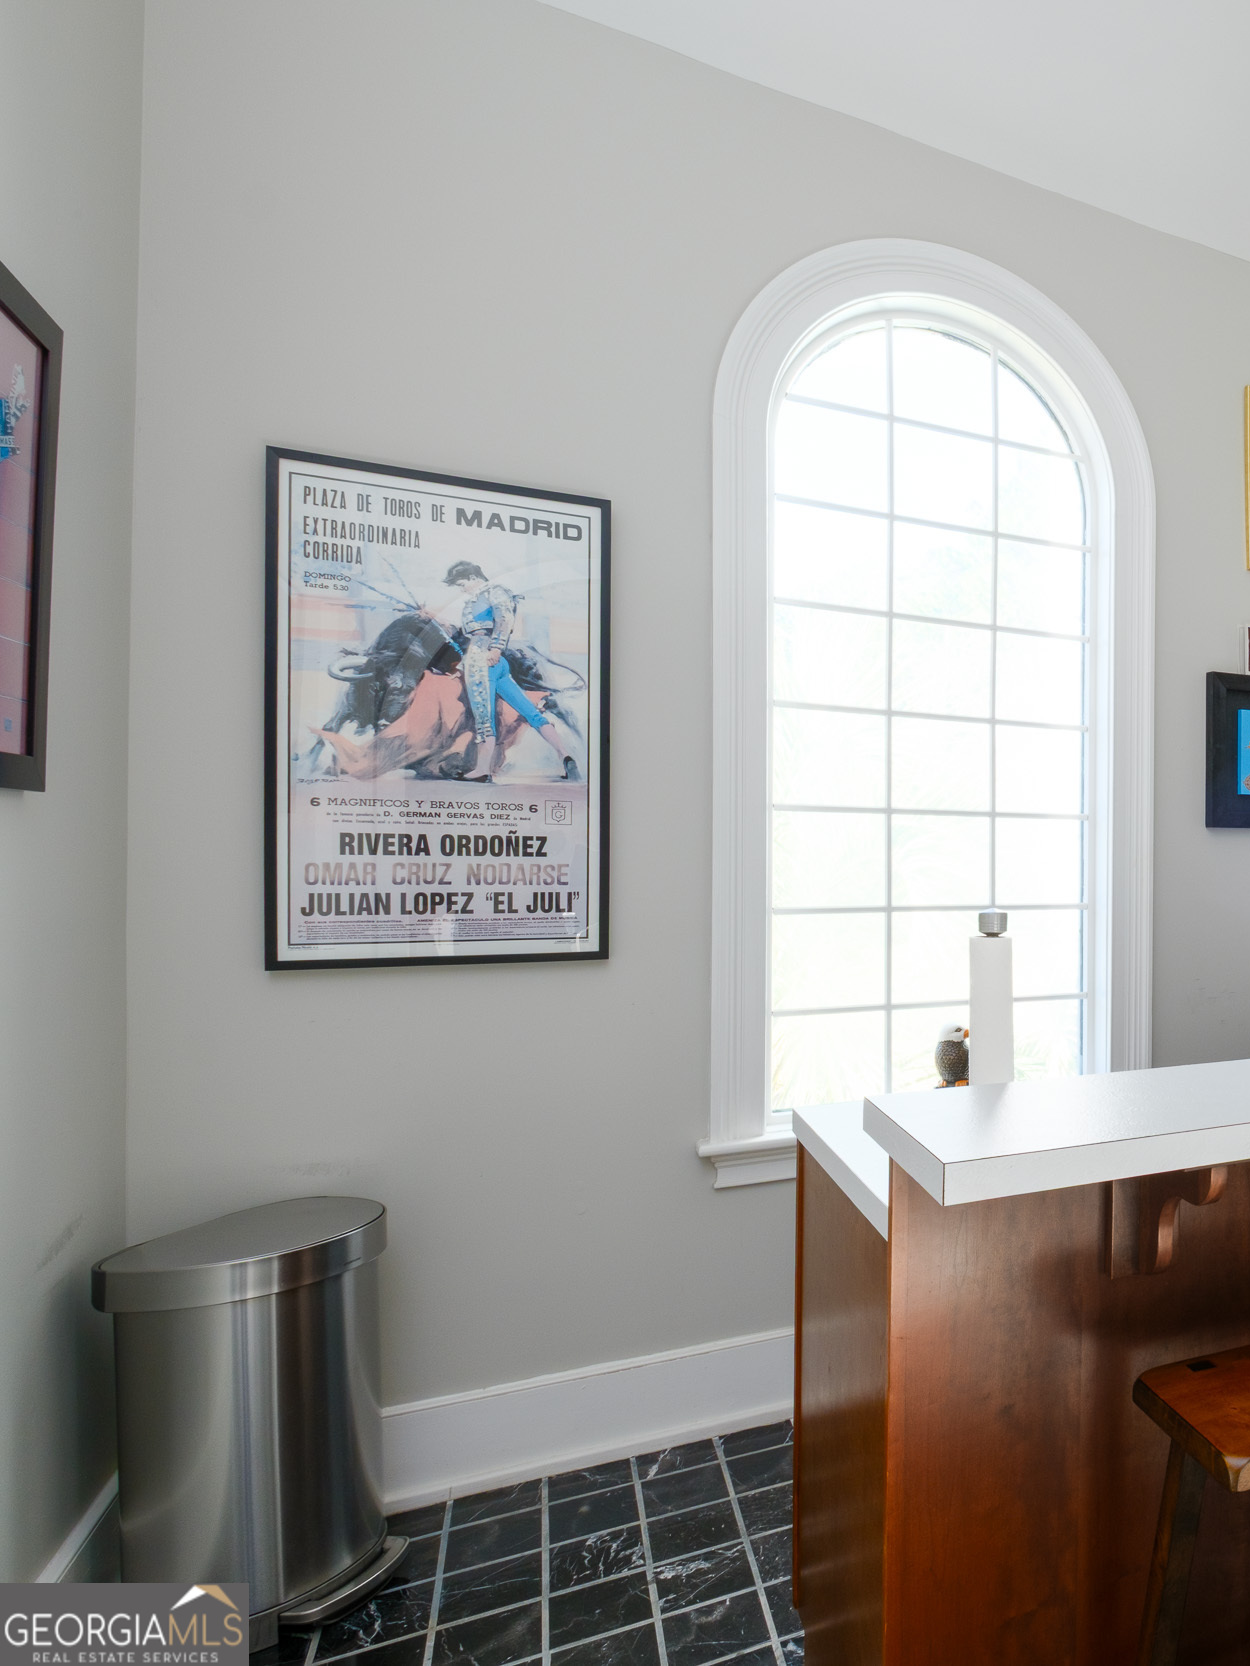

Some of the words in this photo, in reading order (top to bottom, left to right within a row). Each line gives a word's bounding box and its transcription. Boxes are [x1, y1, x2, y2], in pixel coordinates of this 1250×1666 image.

[303, 485, 347, 510] PLAZA
[357, 493, 372, 513] DE
[383, 496, 421, 520] TOROS
[431, 503, 446, 523] DE
[456, 507, 583, 542] MADRID
[303, 515, 421, 549] EXTRAORDINARIA
[303, 540, 363, 565] CORRIDA
[304, 571, 352, 583] DOMINGO
[304, 581, 330, 590] Tarde
[333, 584, 349, 592] 5.30
[310, 797, 321, 807] 6
[327, 797, 410, 808] MAGNIFICOS
[416, 800, 425, 809] Y
[430, 801, 480, 810] BRAVOS
[485, 802, 524, 811] TOROS
[528, 804, 539, 813] 6
[399, 811, 442, 819] GERMAN
[446, 812, 485, 820] GERVAS
[490, 813, 511, 821] DIEZ
[339, 832, 431, 857] RIVERA
[440, 830, 548, 857] ORDOÑEZ
[304, 862, 377, 886] OMAR
[391, 862, 453, 886] CRUZ
[466, 862, 570, 886] NODARSE
[300, 892, 391, 917] JULIAN
[400, 892, 474, 916] LOPEZ
